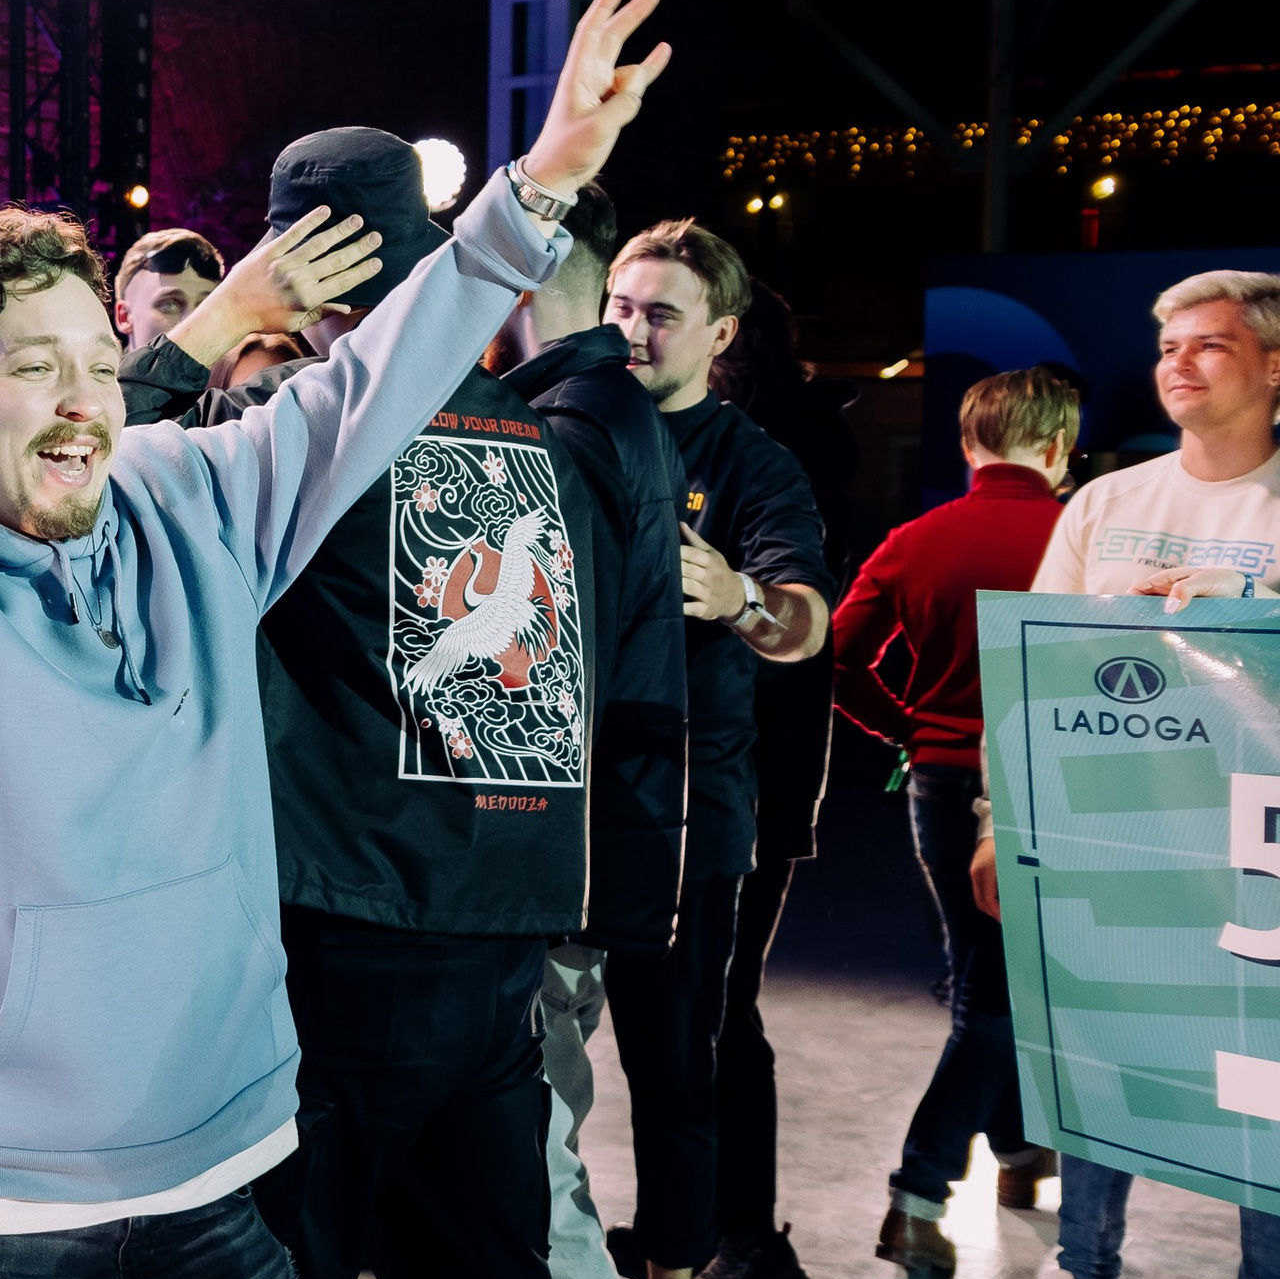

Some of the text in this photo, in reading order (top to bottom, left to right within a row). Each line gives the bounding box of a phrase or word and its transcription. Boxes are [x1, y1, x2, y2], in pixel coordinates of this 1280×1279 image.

[461, 415, 500, 433] YOUR
[500, 419, 541, 440] DREAM
[1053, 708, 1211, 744] LADOGA
